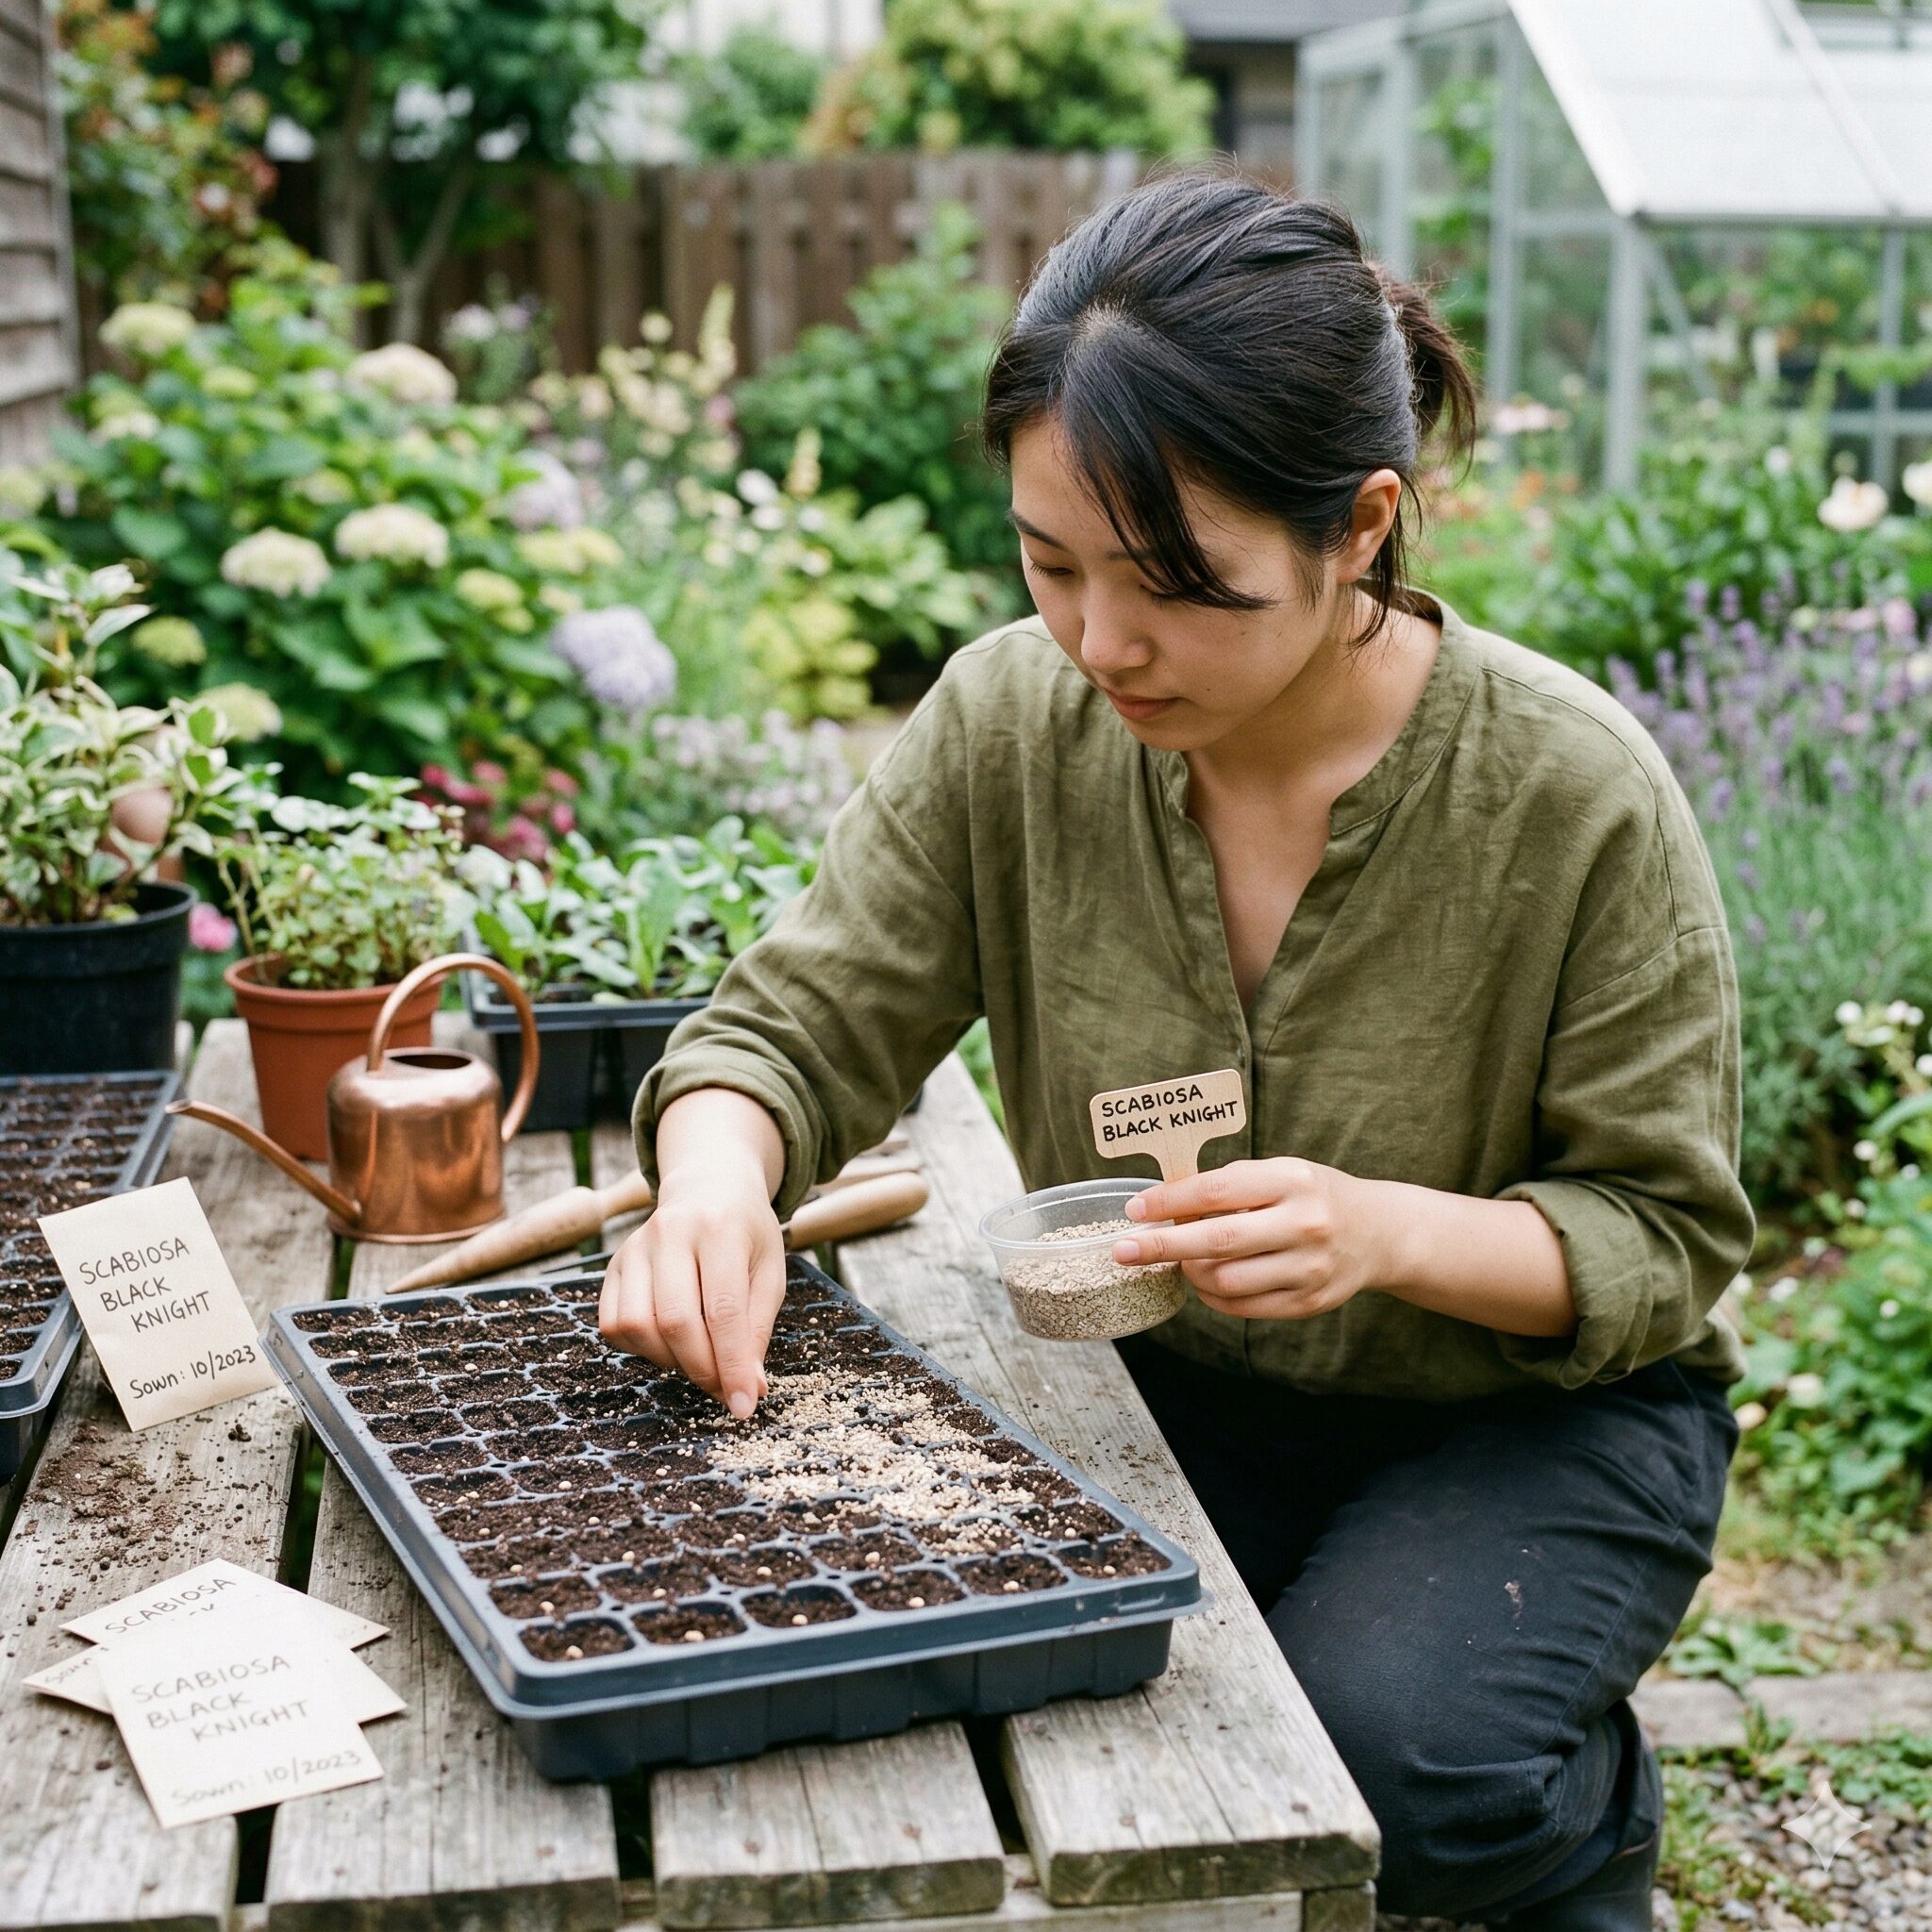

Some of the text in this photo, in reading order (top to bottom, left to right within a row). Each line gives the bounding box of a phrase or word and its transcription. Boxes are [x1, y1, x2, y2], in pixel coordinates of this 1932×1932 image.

[1102, 1084, 1203, 1117] SCABIOSA
[1103, 1101, 1238, 1141] BLACK KNIGHT
[79, 1237, 190, 1285] SCABIOSA
[100, 1276, 172, 1312] BLACK
[131, 1291, 210, 1332] KNIGHT
[129, 1345, 257, 1399] Sown: 10/2023
[105, 1578, 237, 1634] SCABIOSA
[131, 1655, 291, 1704] SCABIOSA
[146, 1691, 251, 1728] BLACK
[192, 1699, 308, 1742] KNIGHT
[263, 1750, 361, 1784] 10/2023
